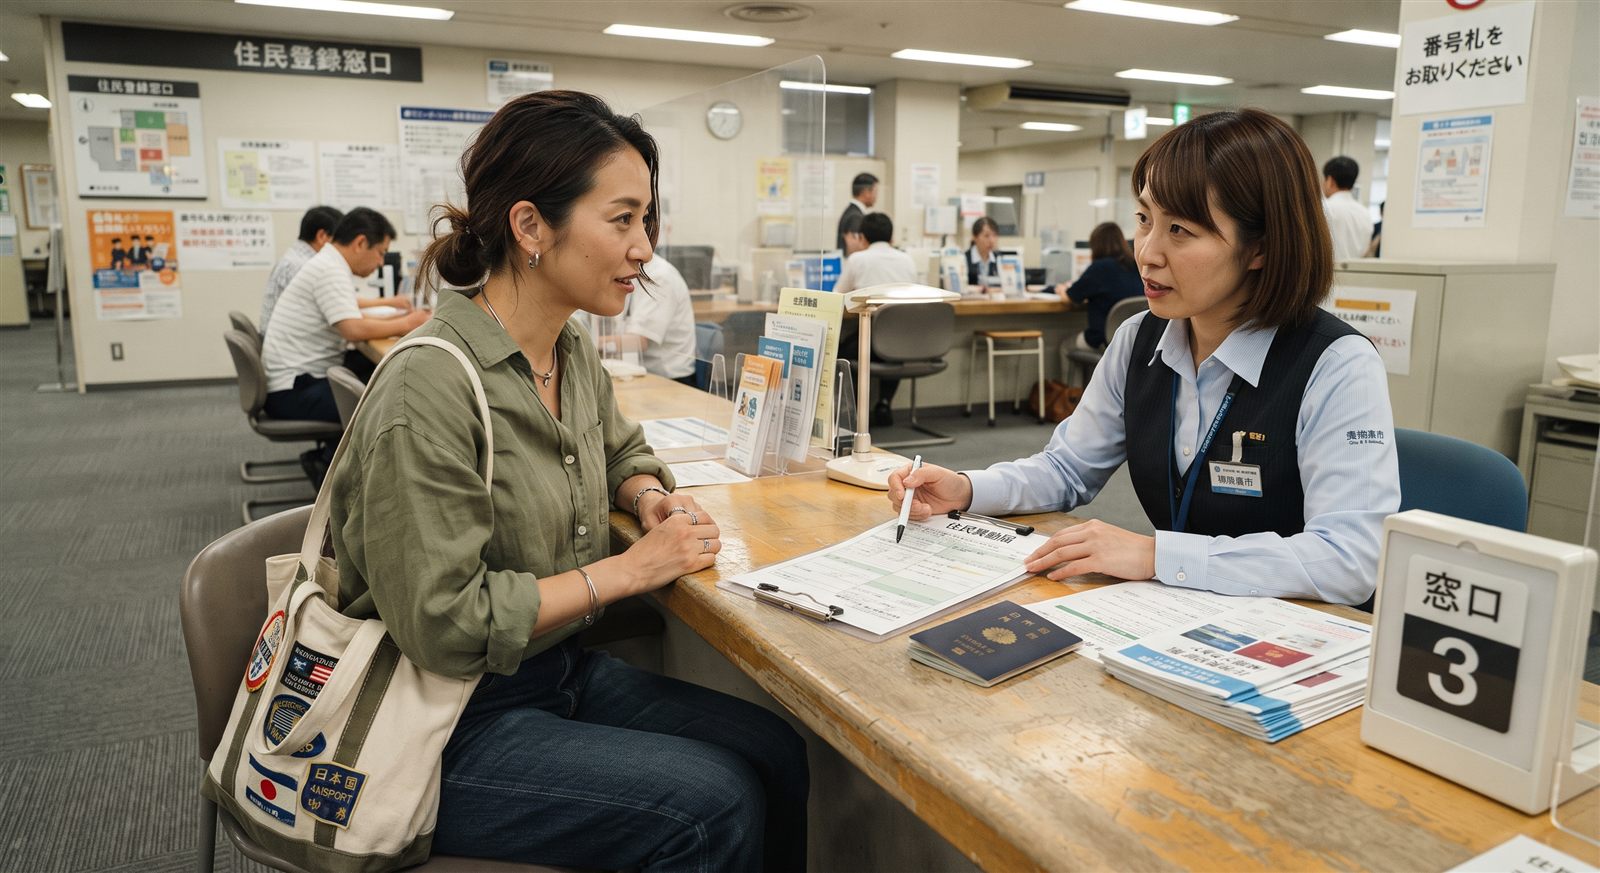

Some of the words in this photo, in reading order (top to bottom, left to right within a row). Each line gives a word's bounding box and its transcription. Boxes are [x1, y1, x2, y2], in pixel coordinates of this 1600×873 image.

[234, 41, 392, 75] 住民登録窓口
[1423, 25, 1503, 58] 番号札を
[1405, 55, 1523, 86] お取りください
[1422, 571, 1503, 623] 窓口
[1427, 636, 1480, 707] 3
[315, 767, 358, 791] 日本国
